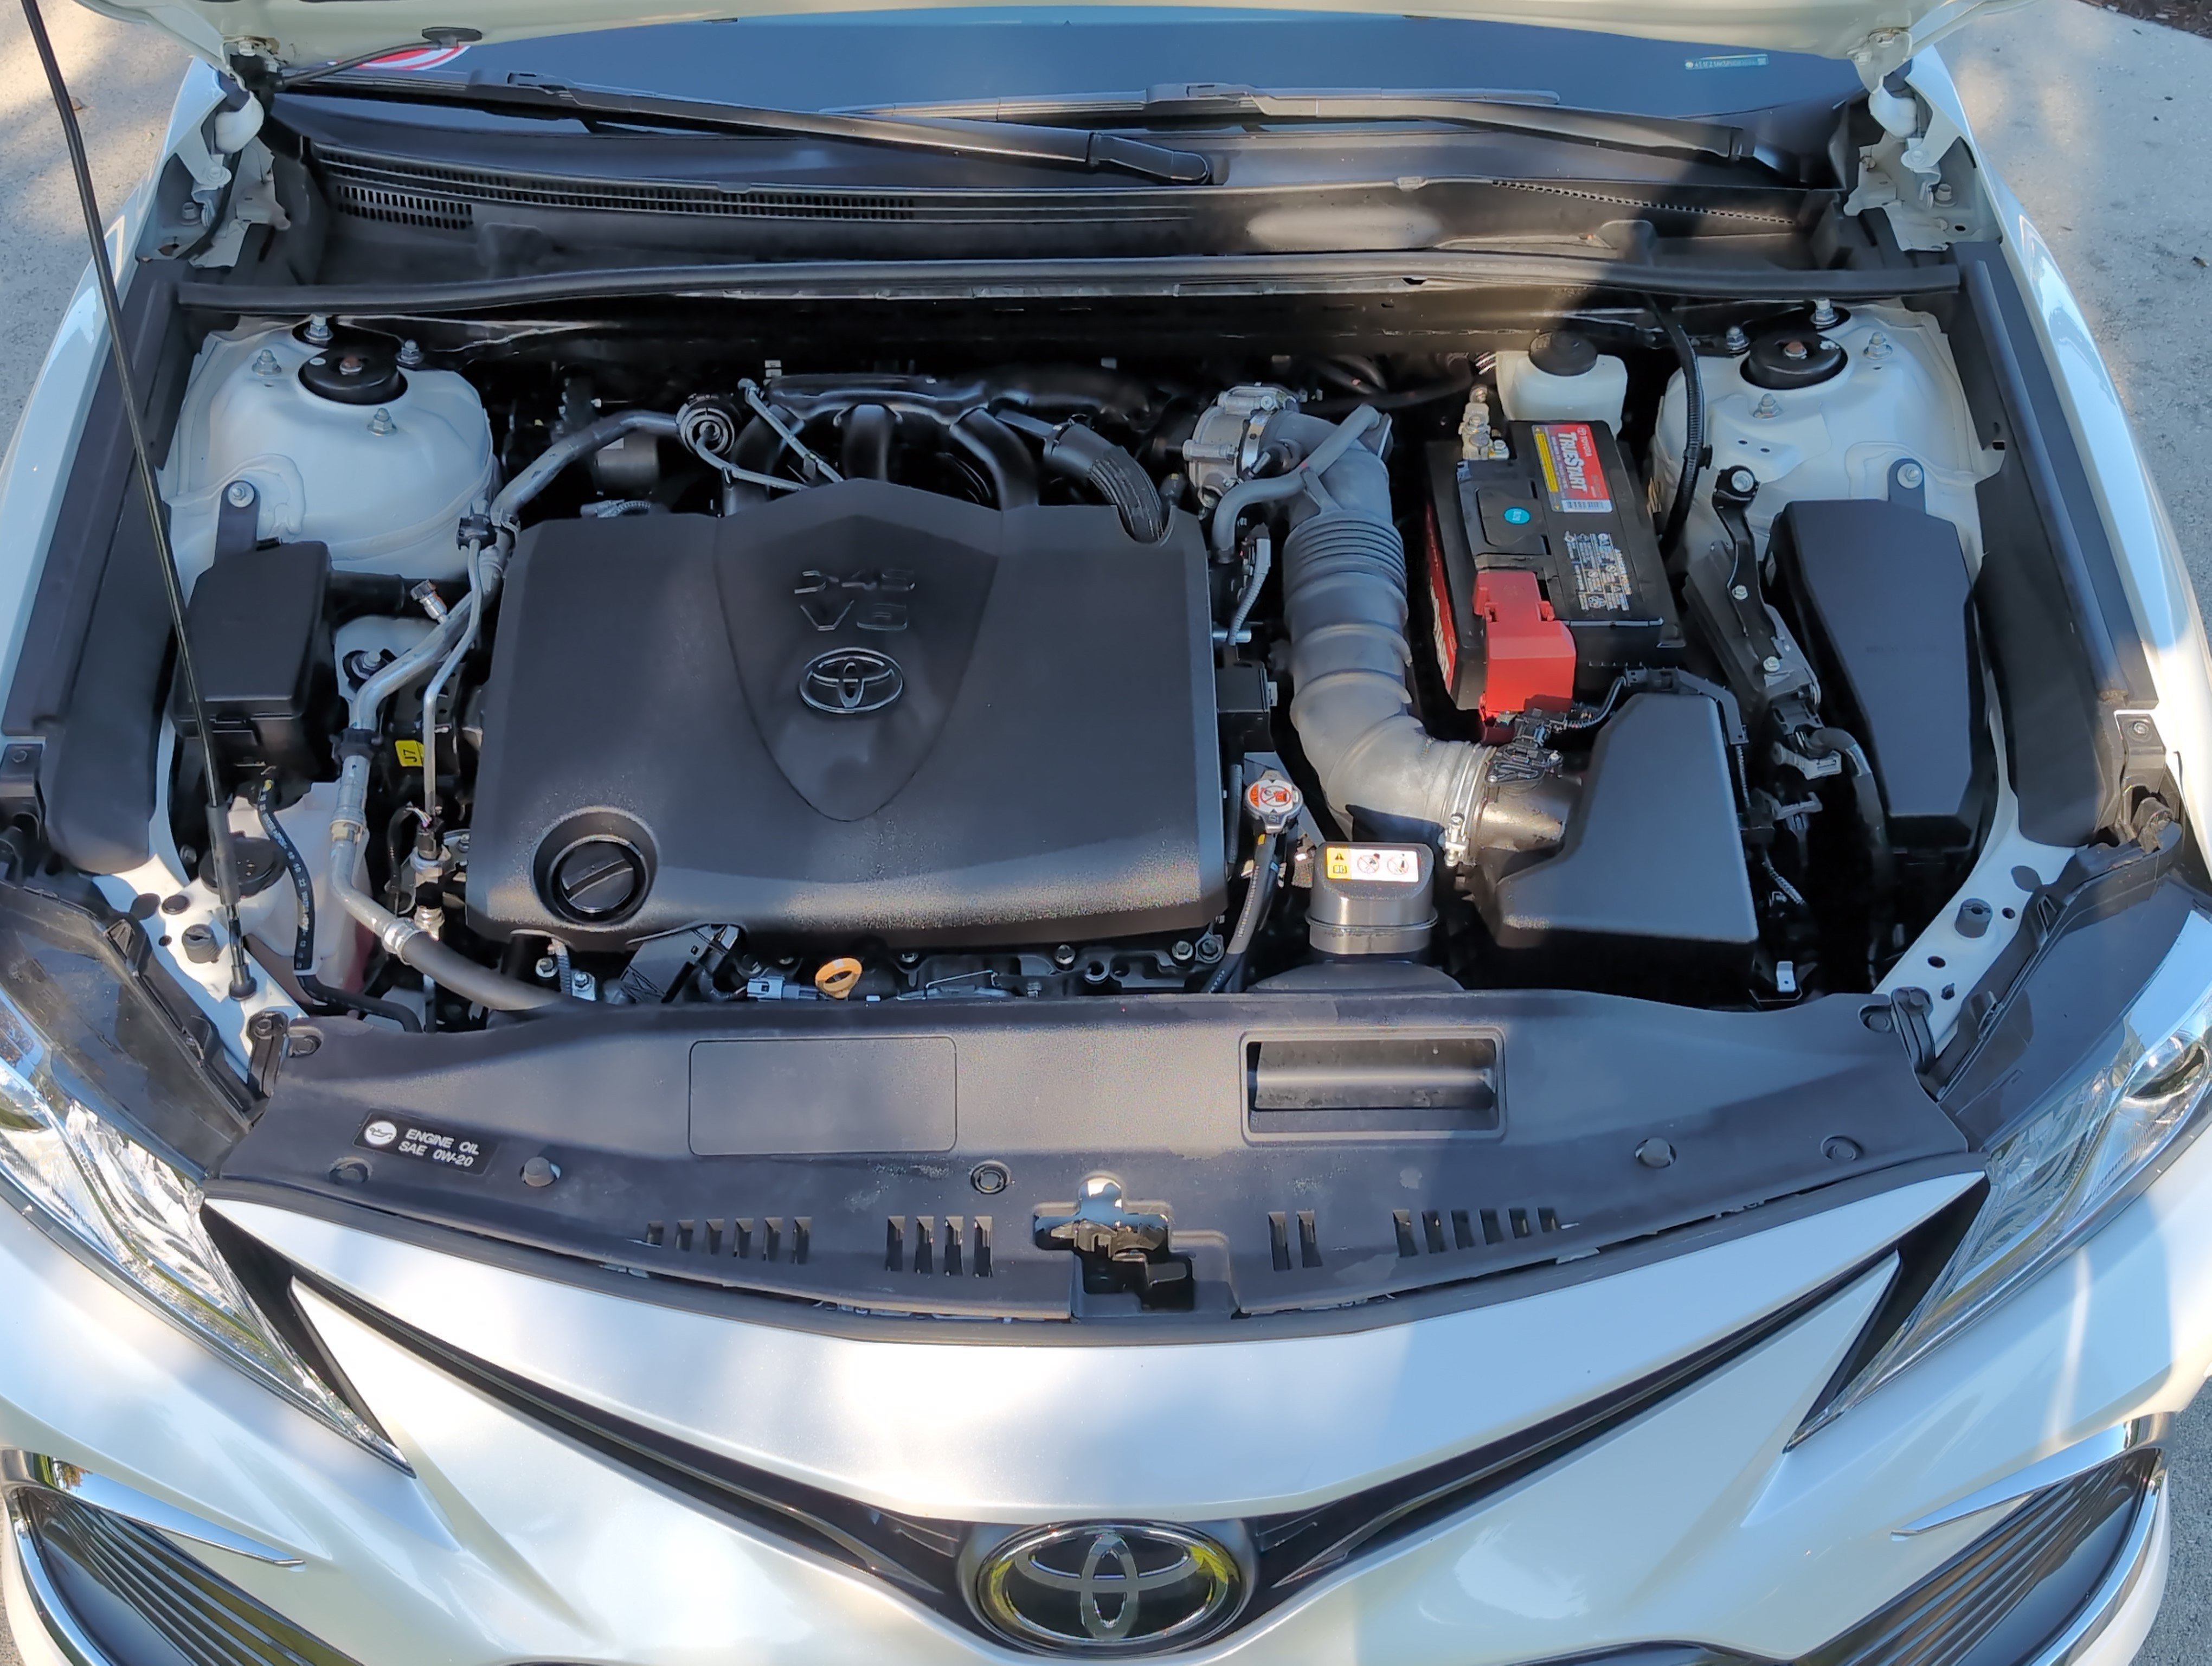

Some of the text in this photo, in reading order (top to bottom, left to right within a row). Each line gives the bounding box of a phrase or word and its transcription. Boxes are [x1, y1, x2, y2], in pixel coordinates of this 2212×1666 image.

[402, 748, 417, 762] J7
[398, 1140, 474, 1167] SAE 0W-20
[406, 1128, 480, 1156] ENGINE OIL
